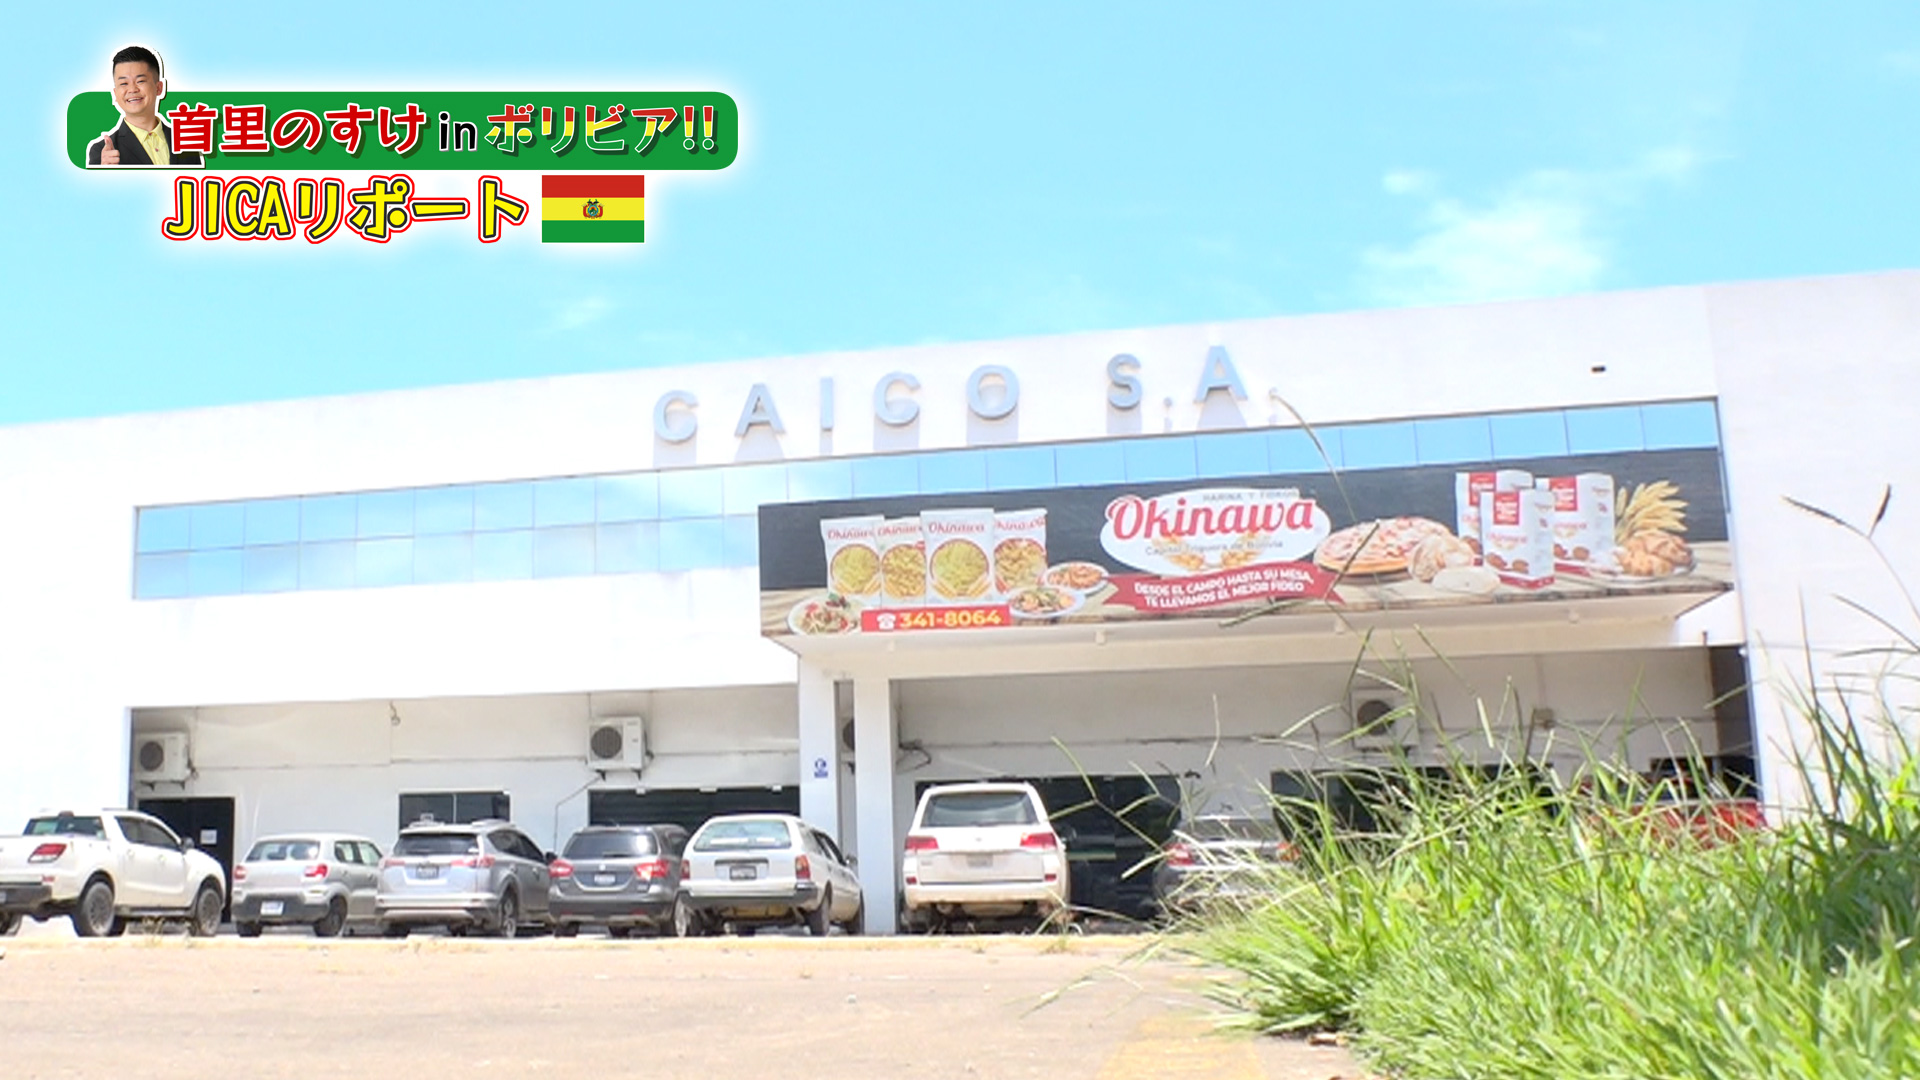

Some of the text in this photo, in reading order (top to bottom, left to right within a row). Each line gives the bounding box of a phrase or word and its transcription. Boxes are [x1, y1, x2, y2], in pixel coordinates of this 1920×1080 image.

[652, 364, 1021, 443] CAICO
[1108, 496, 1313, 541] Okinawa
[1134, 582, 1170, 597] DESDE
[1171, 584, 1186, 596] EL
[1187, 578, 1226, 596] CAMPO
[1226, 572, 1263, 589] HASTA
[1264, 569, 1279, 581] SU
[1145, 580, 1305, 608] TE LLEVAMOS EL MEJOR FIDEO
[900, 609, 1002, 629] 341-8064
